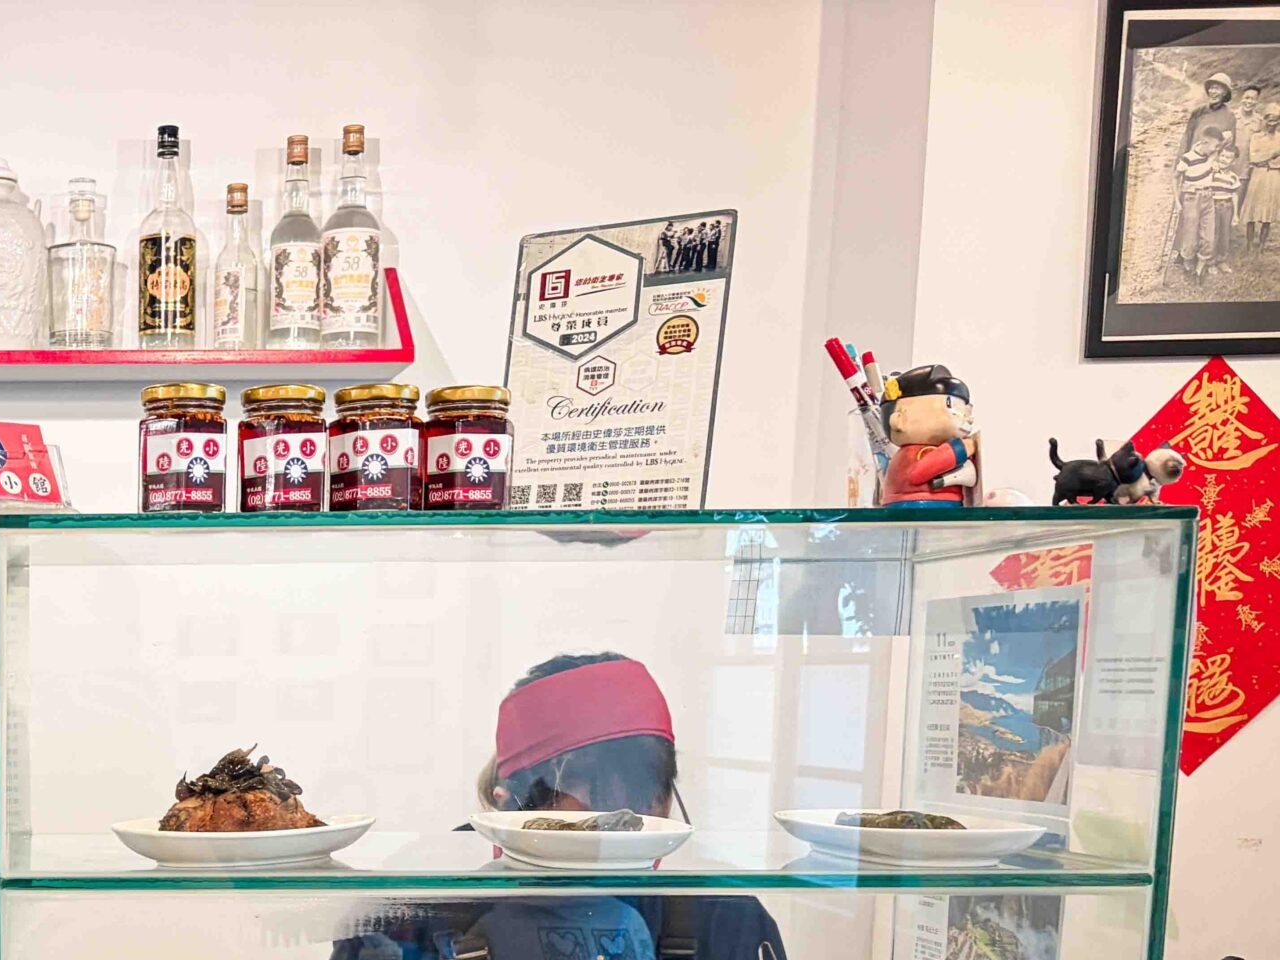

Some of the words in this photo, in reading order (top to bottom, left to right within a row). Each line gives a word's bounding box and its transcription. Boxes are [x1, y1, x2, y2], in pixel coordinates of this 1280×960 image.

[342, 256, 361, 272] 58
[293, 265, 308, 278] 58
[576, 309, 604, 318] Honorable
[604, 307, 628, 315] member
[571, 333, 596, 344] 2024
[547, 395, 667, 426] Certification
[540, 424, 667, 443] 本場所經由史偉莎定期提供
[538, 456, 562, 466] property
[564, 455, 588, 464] provides
[588, 453, 618, 463] periodical
[659, 449, 678, 457] under
[514, 466, 539, 474] excellent
[540, 464, 582, 473] environmental
[583, 462, 603, 472] quality
[604, 460, 634, 469] controlled
[149, 490, 213, 503] (02)8771-8855
[332, 486, 392, 502] (02)8771-8855
[428, 489, 493, 503] (02)8771-8855
